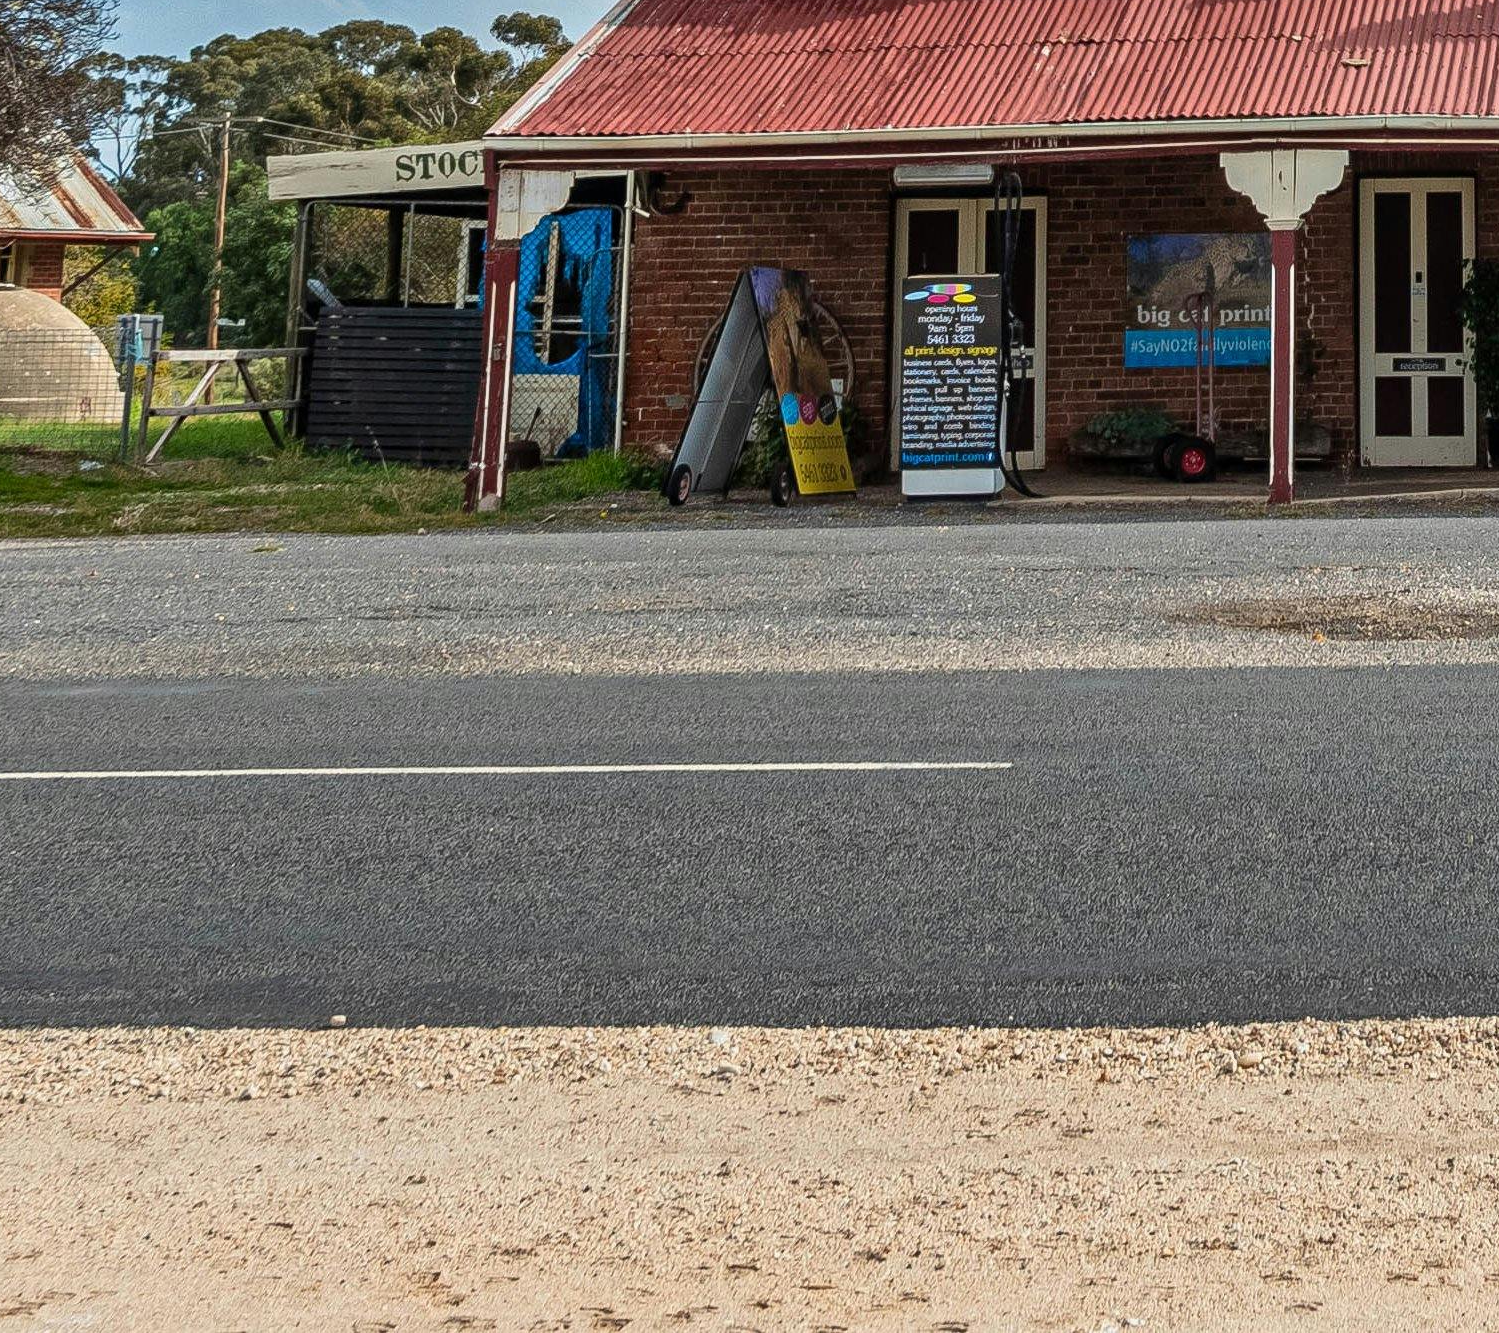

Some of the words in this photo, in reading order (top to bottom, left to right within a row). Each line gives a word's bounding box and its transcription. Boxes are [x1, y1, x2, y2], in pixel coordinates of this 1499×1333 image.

[395, 149, 485, 182] STOC
[918, 314, 953, 324] monday
[960, 313, 985, 323] friday
[1137, 305, 1171, 327] big
[927, 324, 948, 333] 9am
[955, 323, 975, 333] 5pm
[927, 334, 949, 344] 5461
[952, 334, 976, 344] 3323
[902, 452, 984, 467] bigcatprint.com
